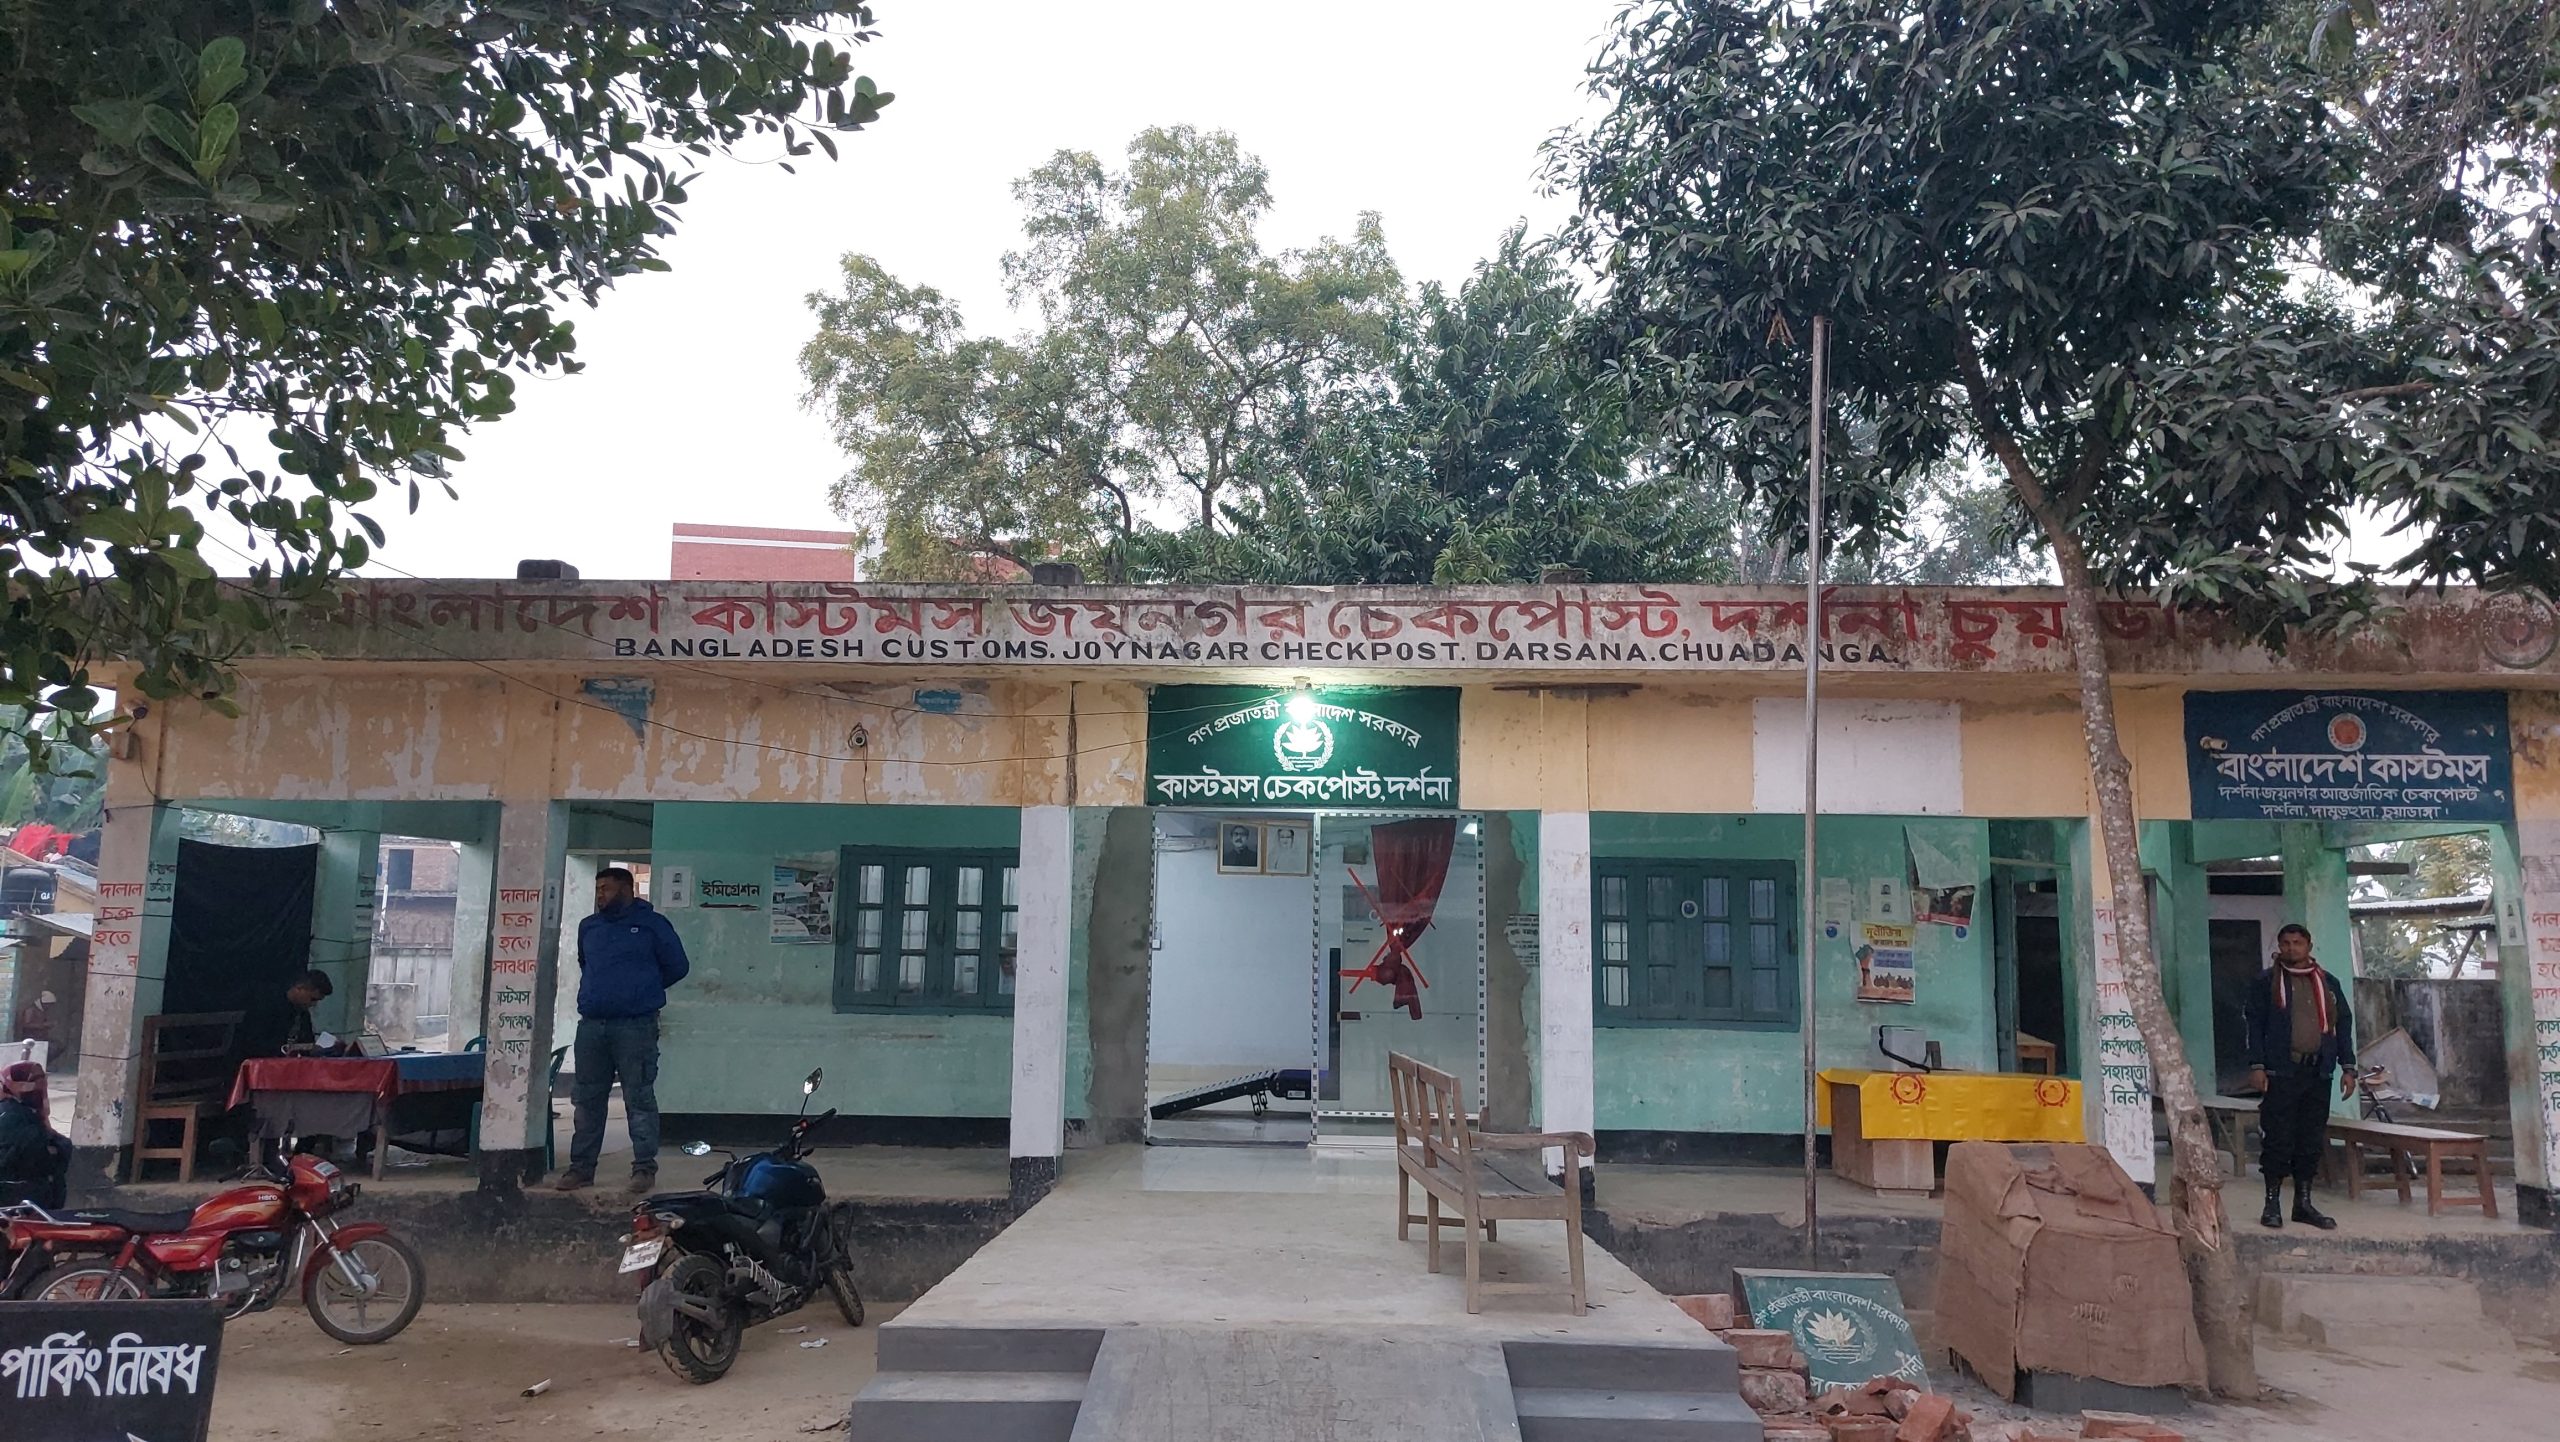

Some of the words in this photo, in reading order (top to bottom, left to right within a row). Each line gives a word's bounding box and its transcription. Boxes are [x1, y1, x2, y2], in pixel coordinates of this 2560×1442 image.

[614, 637, 864, 659] BANGLADESH
[2320, 695, 2389, 713] বাংলাদেশ
[2389, 704, 2442, 744] সরকার
[1359, 710, 1424, 749] সরকার
[2214, 747, 2365, 784] বাংলাদেশ
[2402, 784, 2481, 803] চেকপোস্ট
[100, 882, 144, 899] দালাল
[499, 889, 541, 905] দালাল
[701, 879, 760, 897] ইমিগ্রেশন
[501, 912, 534, 928] চক্র
[94, 930, 132, 947] হতে
[498, 936, 533, 954] হতে
[492, 958, 538, 974] সাবধান
[0, 1330, 103, 1398] পার্কিং
[105, 1332, 207, 1396] নিষেধ
